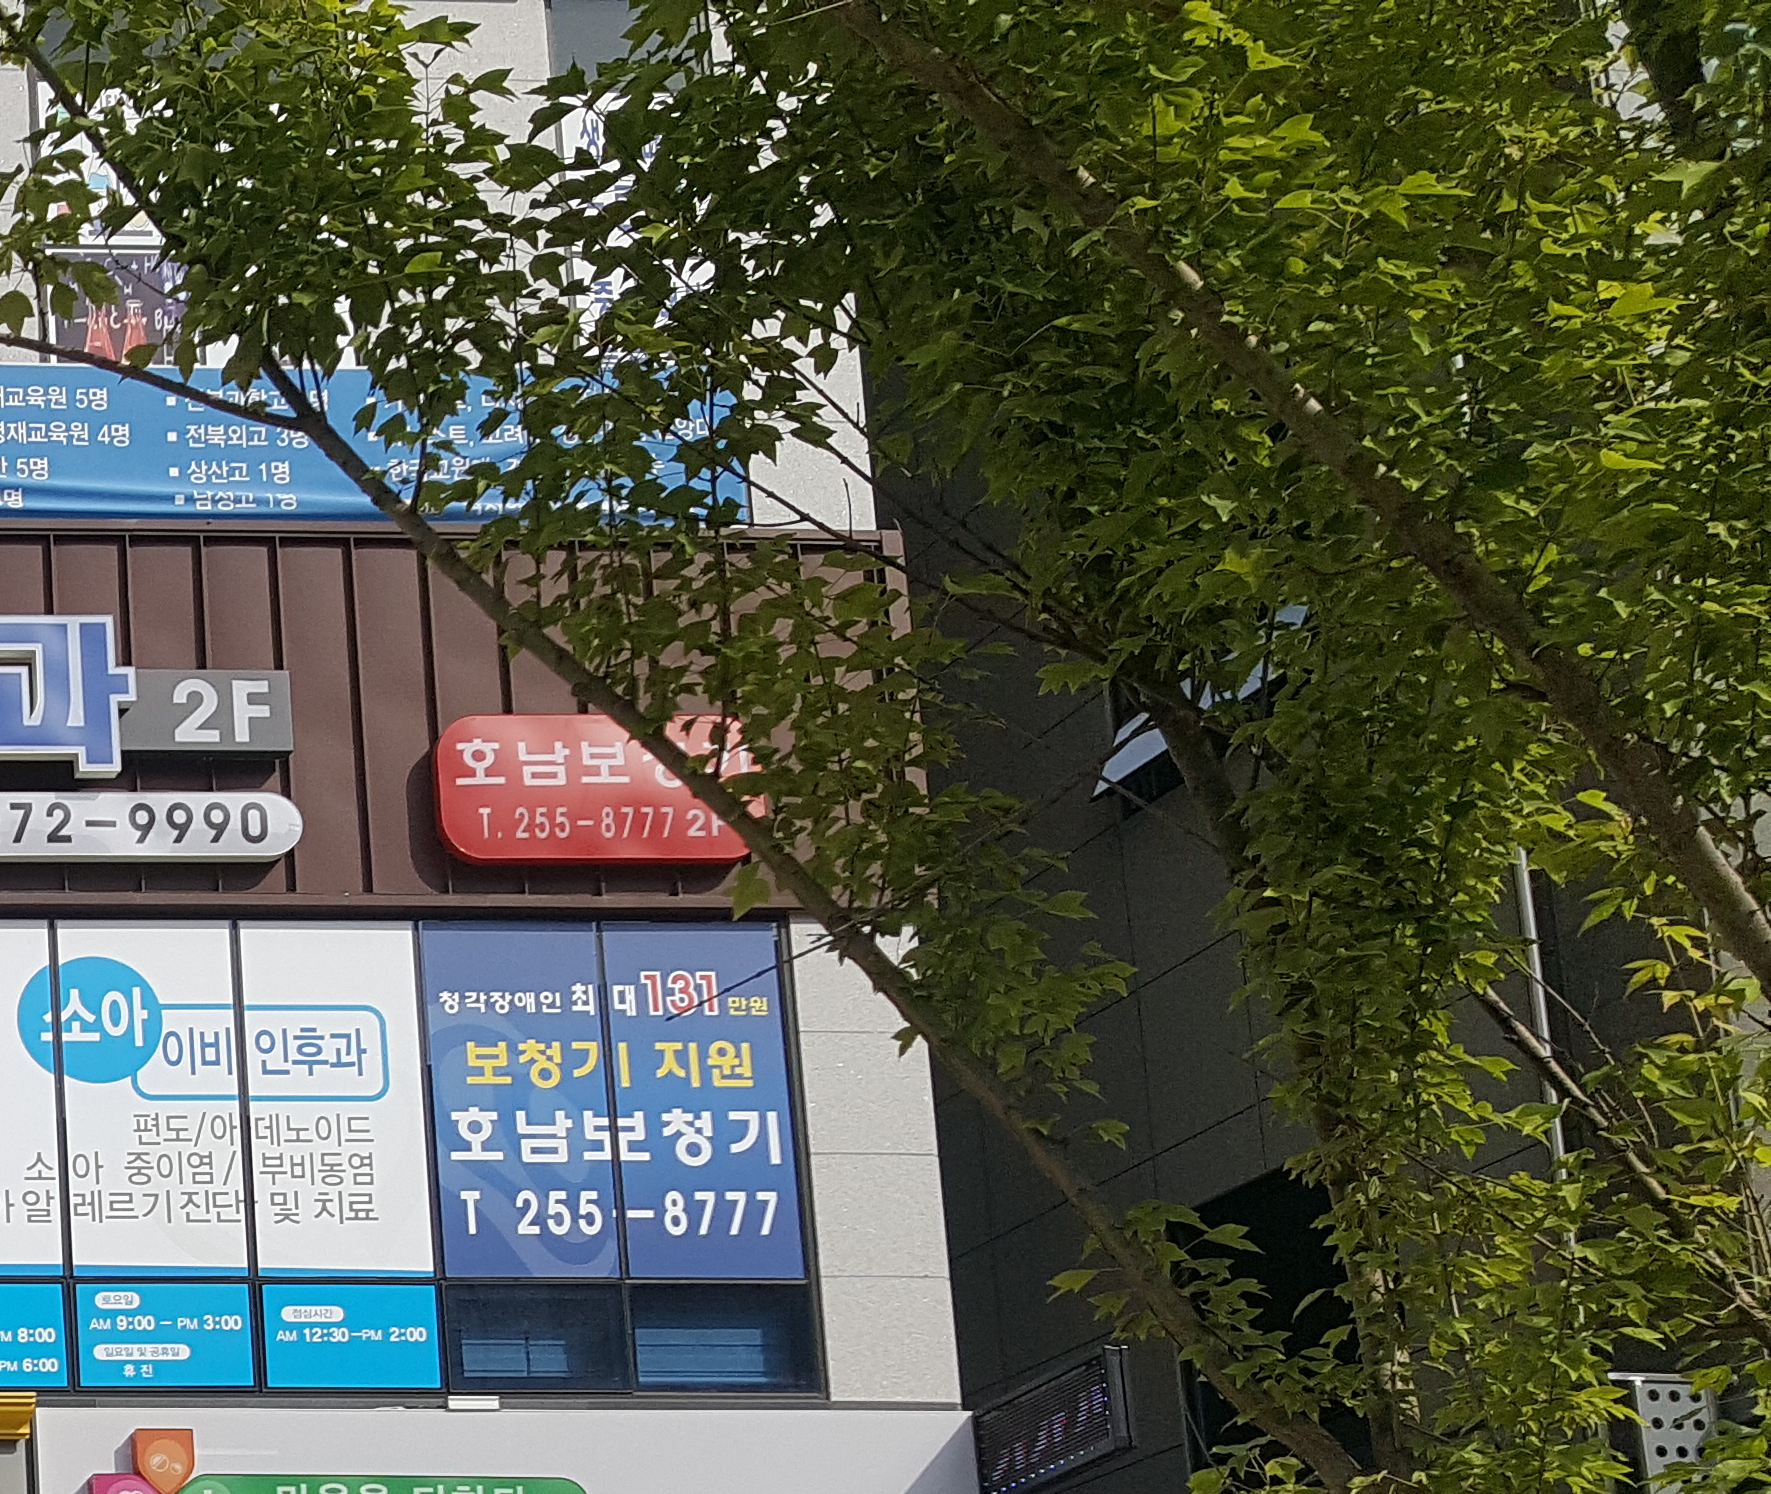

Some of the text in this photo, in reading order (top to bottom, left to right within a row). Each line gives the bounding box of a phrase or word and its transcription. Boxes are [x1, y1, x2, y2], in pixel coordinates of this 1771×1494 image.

[75, 386, 109, 411] 5명
[98, 421, 130, 447] 4명
[186, 424, 268, 448] 전북외고
[16, 457, 49, 480] 5명
[187, 460, 290, 484] 상산고 1명
[193, 490, 256, 510] 남성고
[172, 679, 270, 743] 2F
[514, 807, 675, 838] 255-8777
[439, 982, 636, 1017] 청각장애인 최대
[40, 987, 367, 1076] 소아 이비인후과
[465, 1040, 755, 1089] 보청기 지원
[450, 1106, 782, 1166] 호남보청기
[270, 1191, 380, 1224] 및 치료
[460, 1190, 778, 1237] T 255-8777
[17, 1327, 56, 1343] 8:00
[89, 1315, 242, 1330] AM 9:00 PM 3:00
[276, 1327, 427, 1342] AM 2:00
[22, 1358, 58, 1372] 6:00
